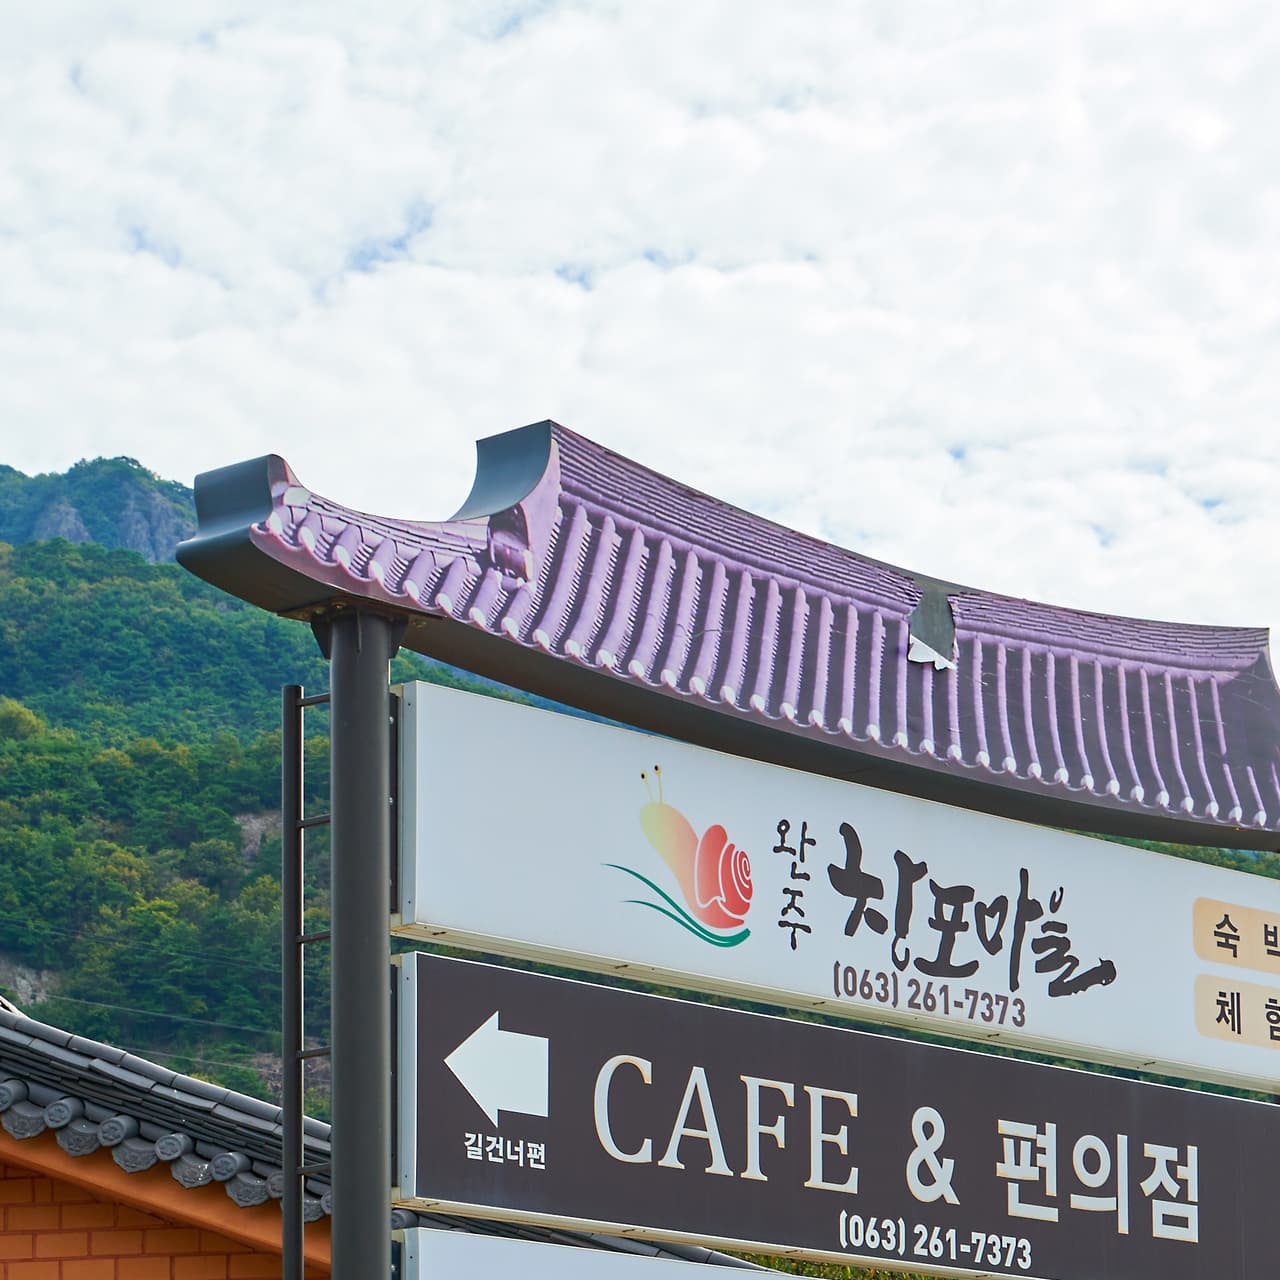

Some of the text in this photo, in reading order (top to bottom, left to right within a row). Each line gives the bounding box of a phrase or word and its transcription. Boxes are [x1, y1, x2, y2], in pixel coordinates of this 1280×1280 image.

[773, 819, 816, 950] 완주
[827, 822, 1117, 998] 창포마을
[907, 978, 1026, 1028] 261-7373
[464, 1132, 546, 1171] 길건너편
[593, 1054, 1199, 1243] CAFE & 편의점
[914, 1223, 1032, 1270] 261-7373
